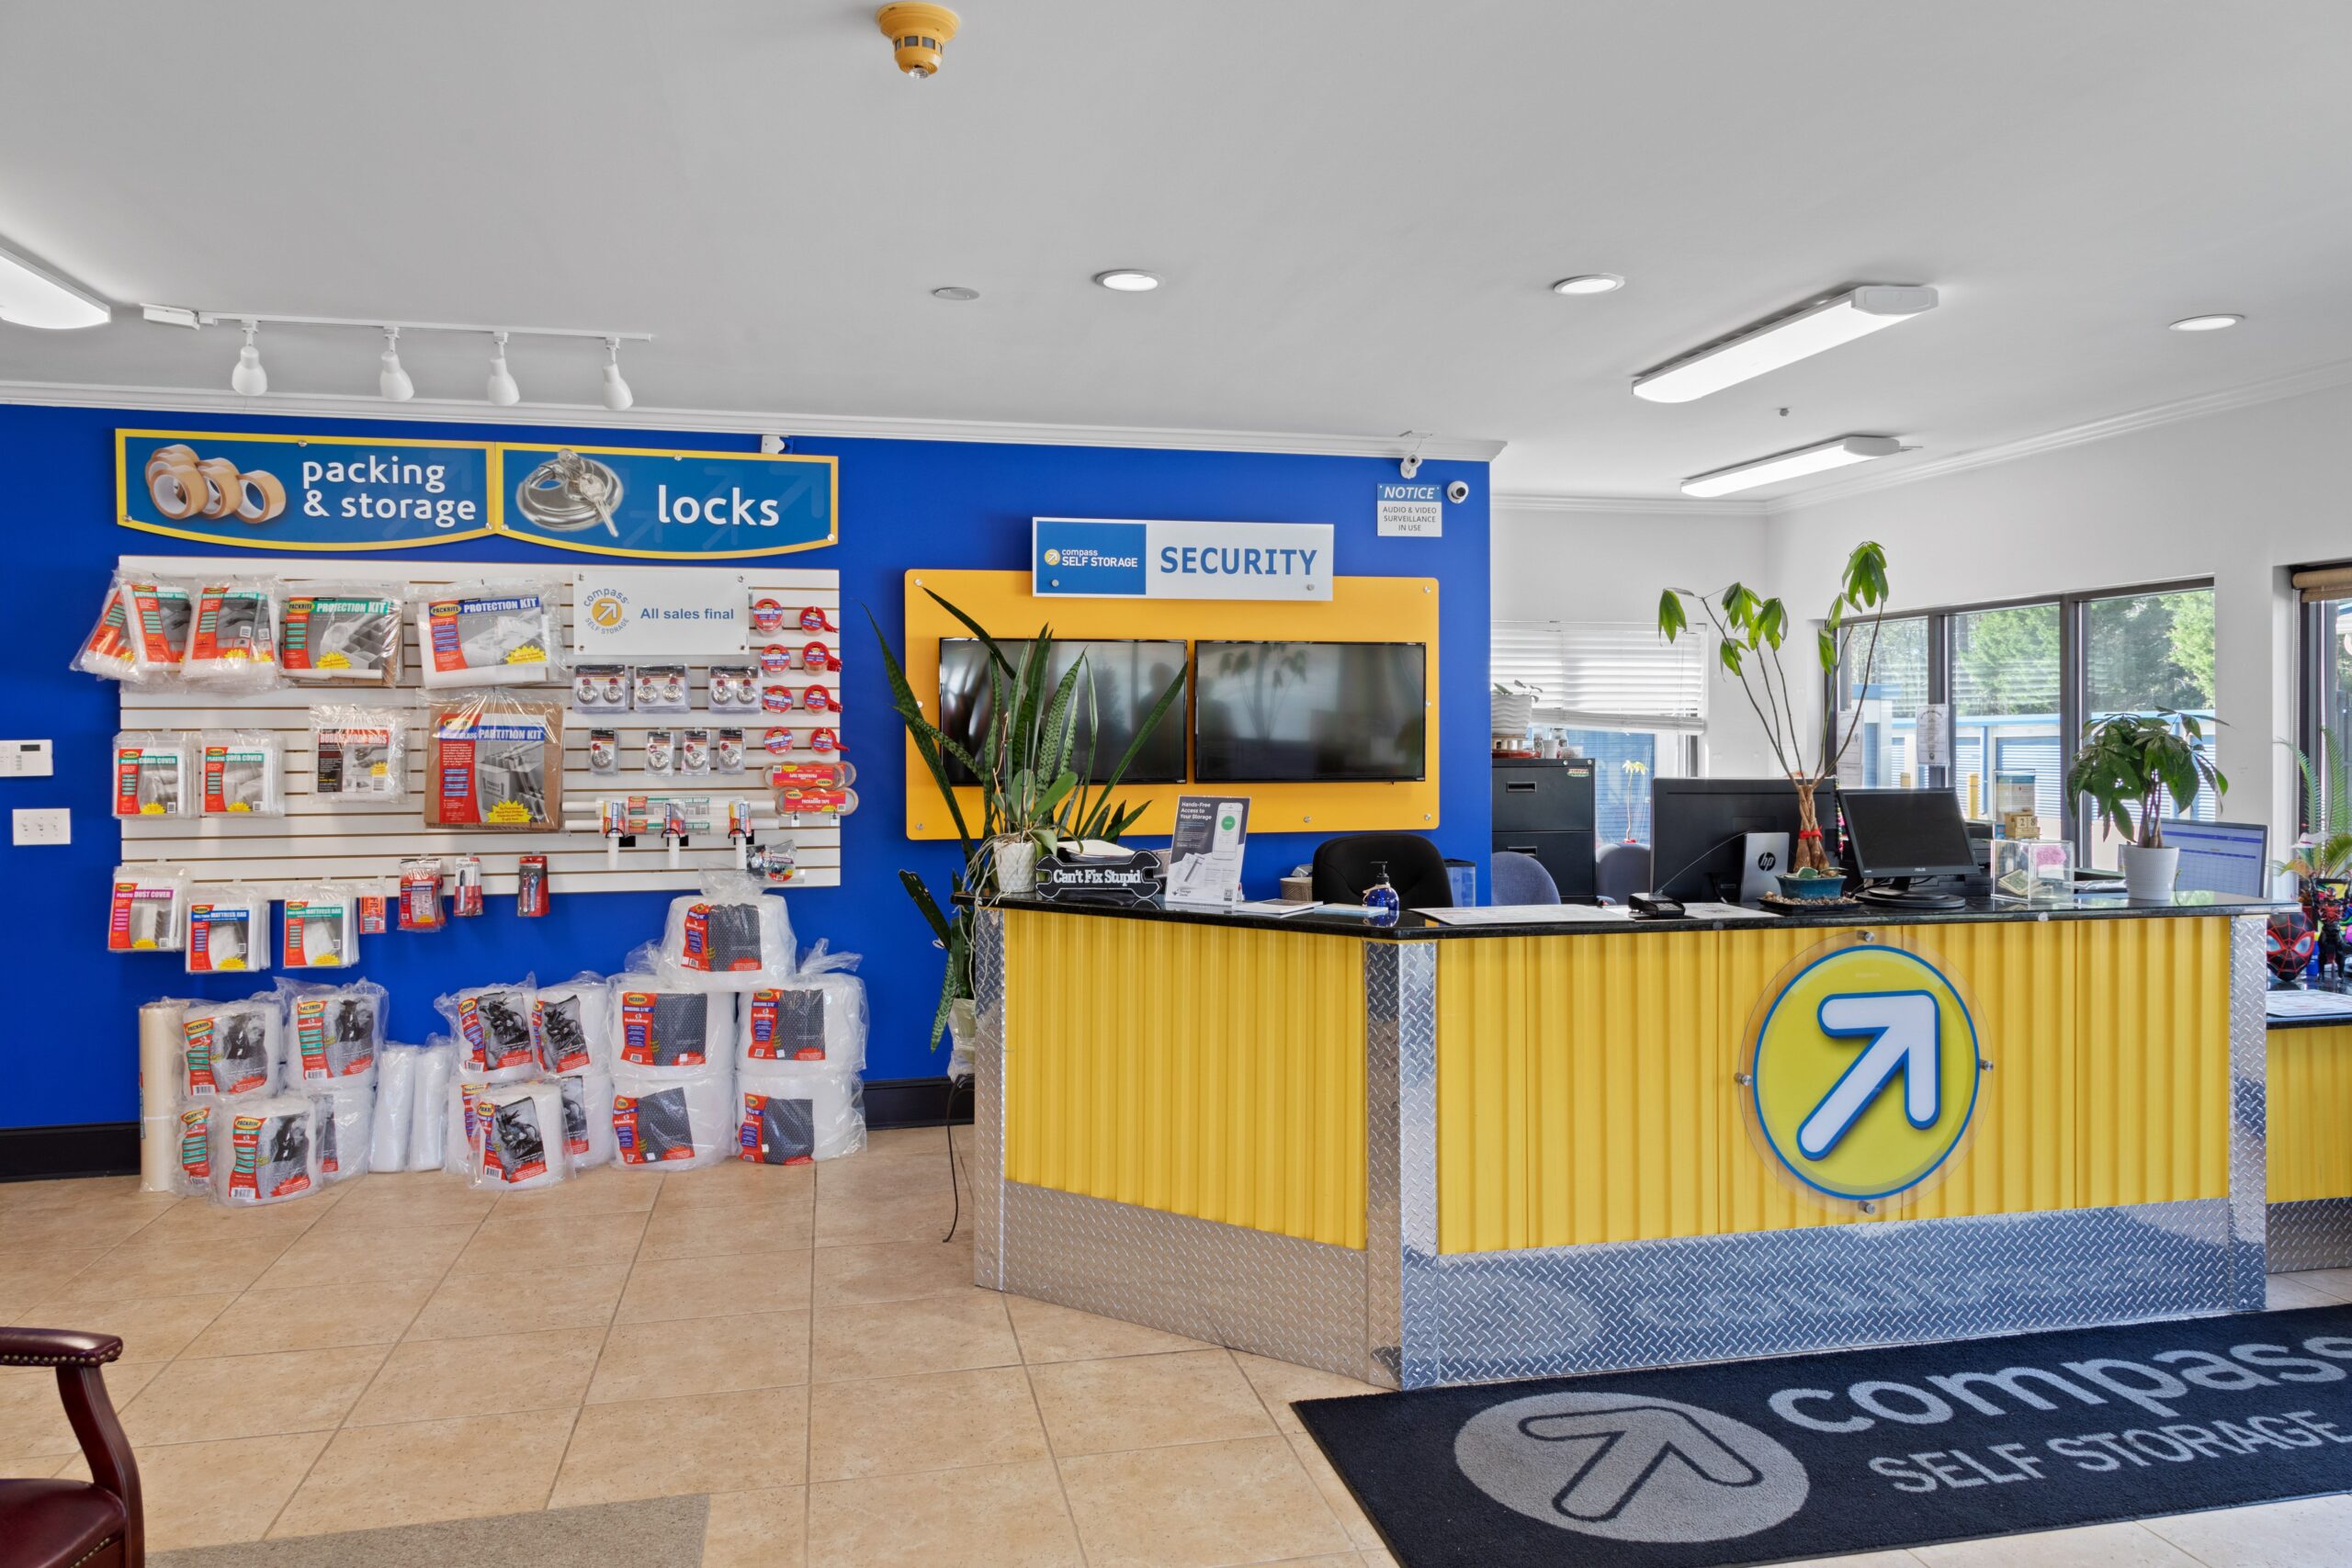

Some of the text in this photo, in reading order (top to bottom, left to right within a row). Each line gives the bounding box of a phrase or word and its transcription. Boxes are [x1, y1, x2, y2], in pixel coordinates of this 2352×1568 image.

[302, 455, 446, 494] packing
[1384, 486, 1435, 499] NOTICE
[303, 490, 476, 528] & storage
[658, 484, 780, 527] locks
[1061, 548, 1098, 558] compass
[1159, 547, 1318, 575] SECURITY
[1062, 556, 1138, 568] SELF STORAGE
[464, 598, 537, 613] PROTECTION KIT
[583, 588, 628, 607] compass
[316, 602, 386, 613] PROTECTION KIT
[640, 608, 734, 619] All sales final
[584, 617, 629, 635] SELF STORAGE
[479, 728, 526, 739] PARTITION
[527, 730, 542, 739] KIT
[2020, 818, 2025, 826] 2
[2030, 818, 2036, 826] 8
[1758, 852, 1775, 871] hp
[1053, 869, 1141, 886] Can't Fix Stupid
[1868, 1410, 2352, 1494] SELF STORAGE
